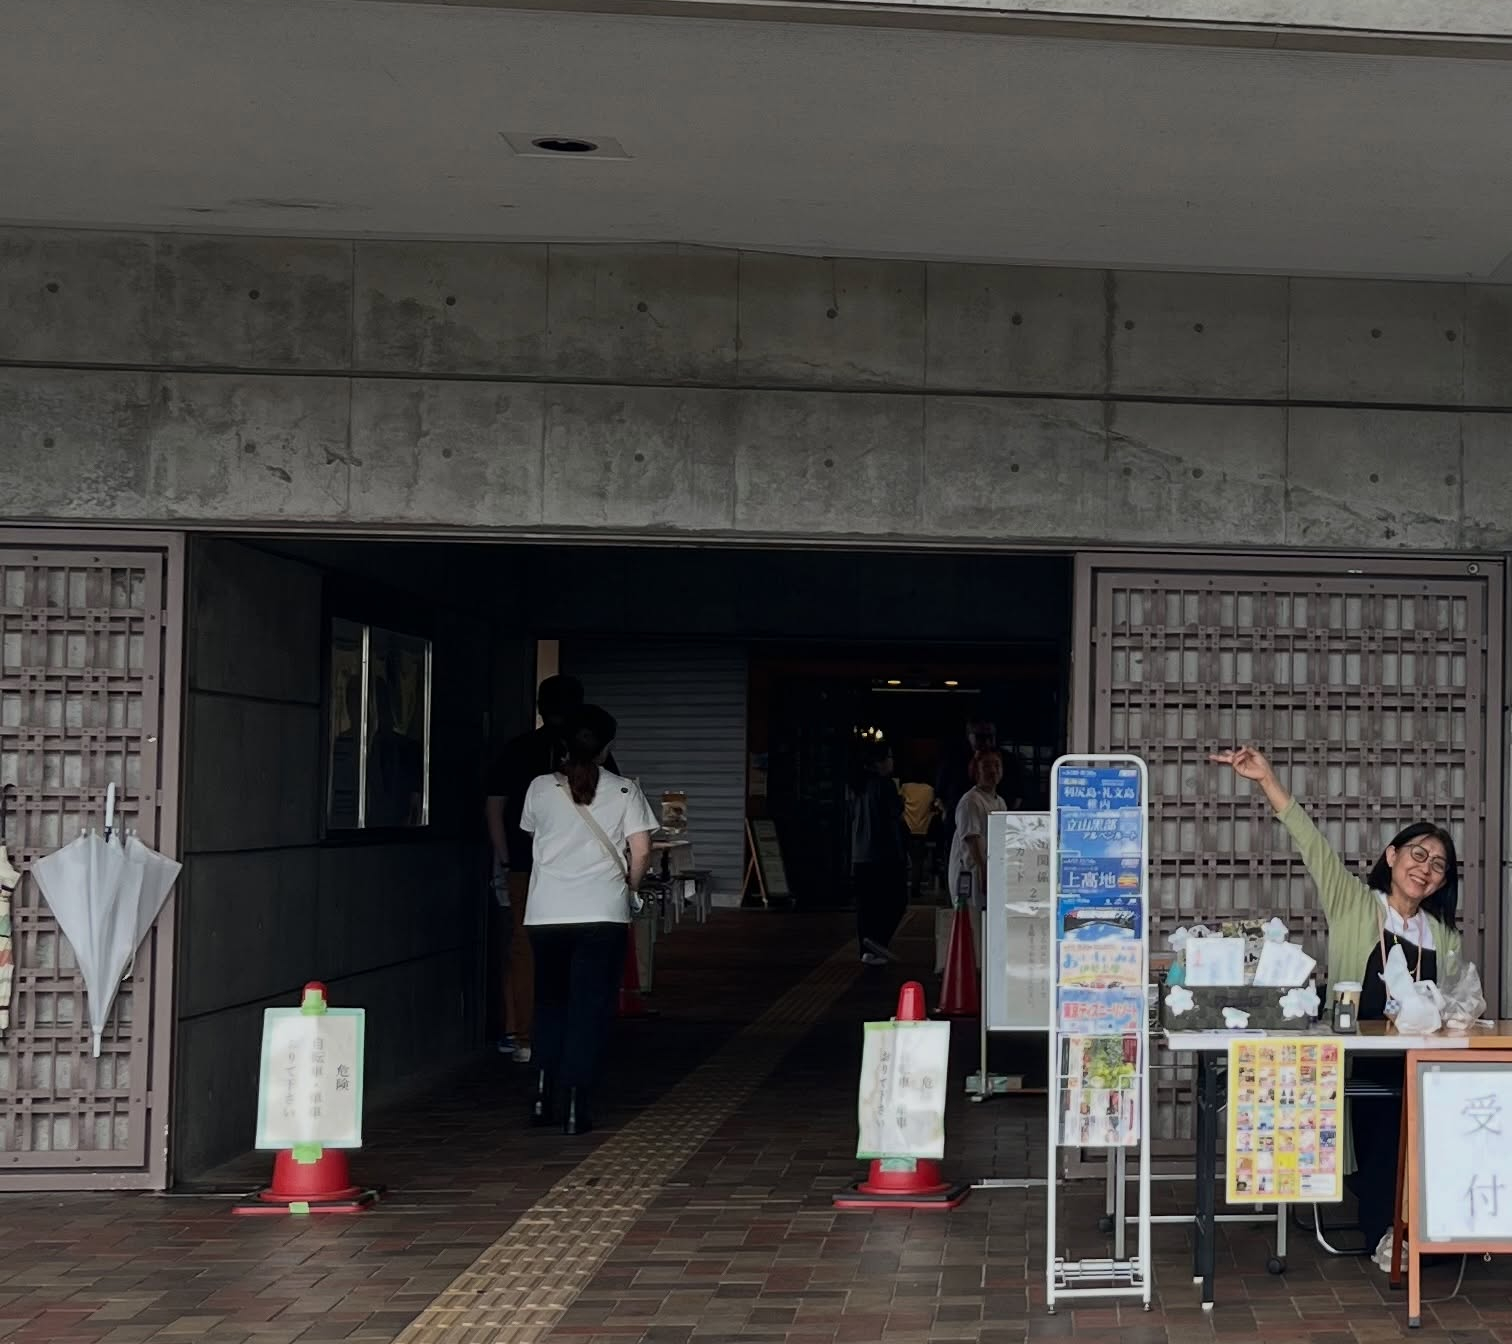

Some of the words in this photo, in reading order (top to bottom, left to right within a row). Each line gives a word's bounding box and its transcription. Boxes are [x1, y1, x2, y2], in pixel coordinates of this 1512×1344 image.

[1062, 871, 1116, 889] 上高地
[336, 1064, 350, 1091] 危険
[1461, 1093, 1506, 1218] 受付
